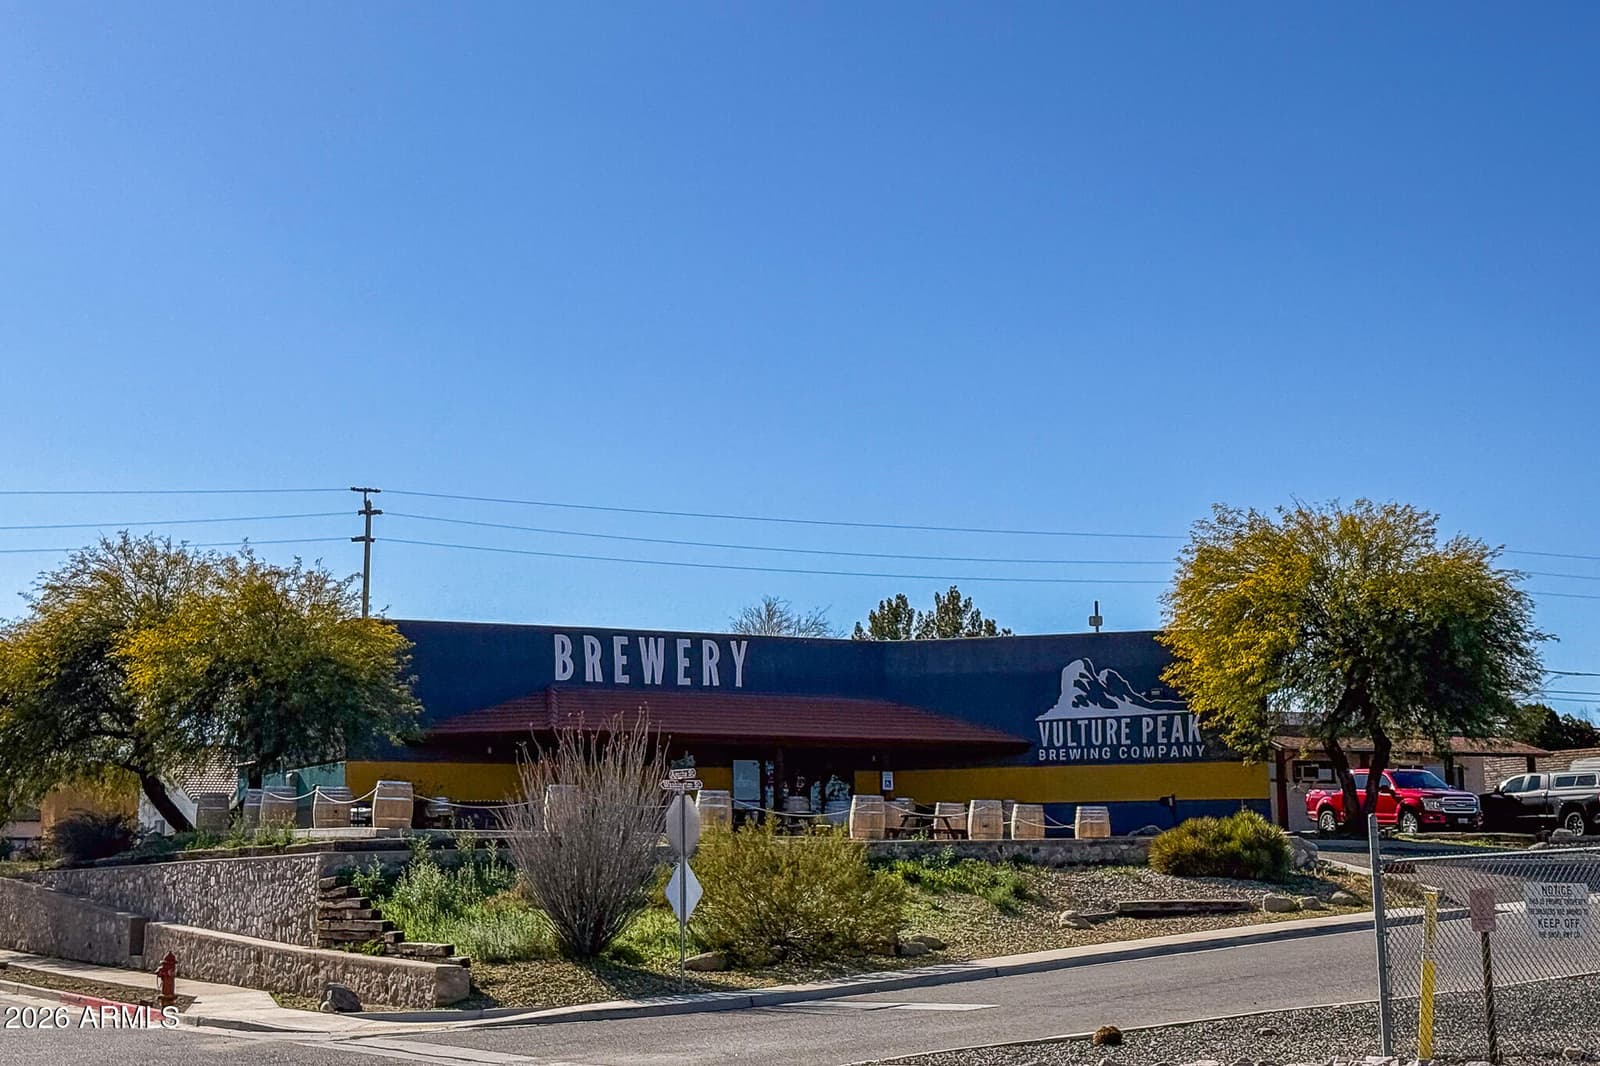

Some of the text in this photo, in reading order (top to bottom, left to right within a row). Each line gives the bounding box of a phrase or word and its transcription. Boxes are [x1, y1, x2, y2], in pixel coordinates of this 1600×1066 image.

[553, 633, 749, 688] BREWERY
[1038, 714, 1202, 747] VULTURE PEAK
[1038, 744, 1206, 761] BREWING COMPANY
[1541, 885, 1573, 897] NOTICE
[1538, 918, 1581, 929] KEEP OFF
